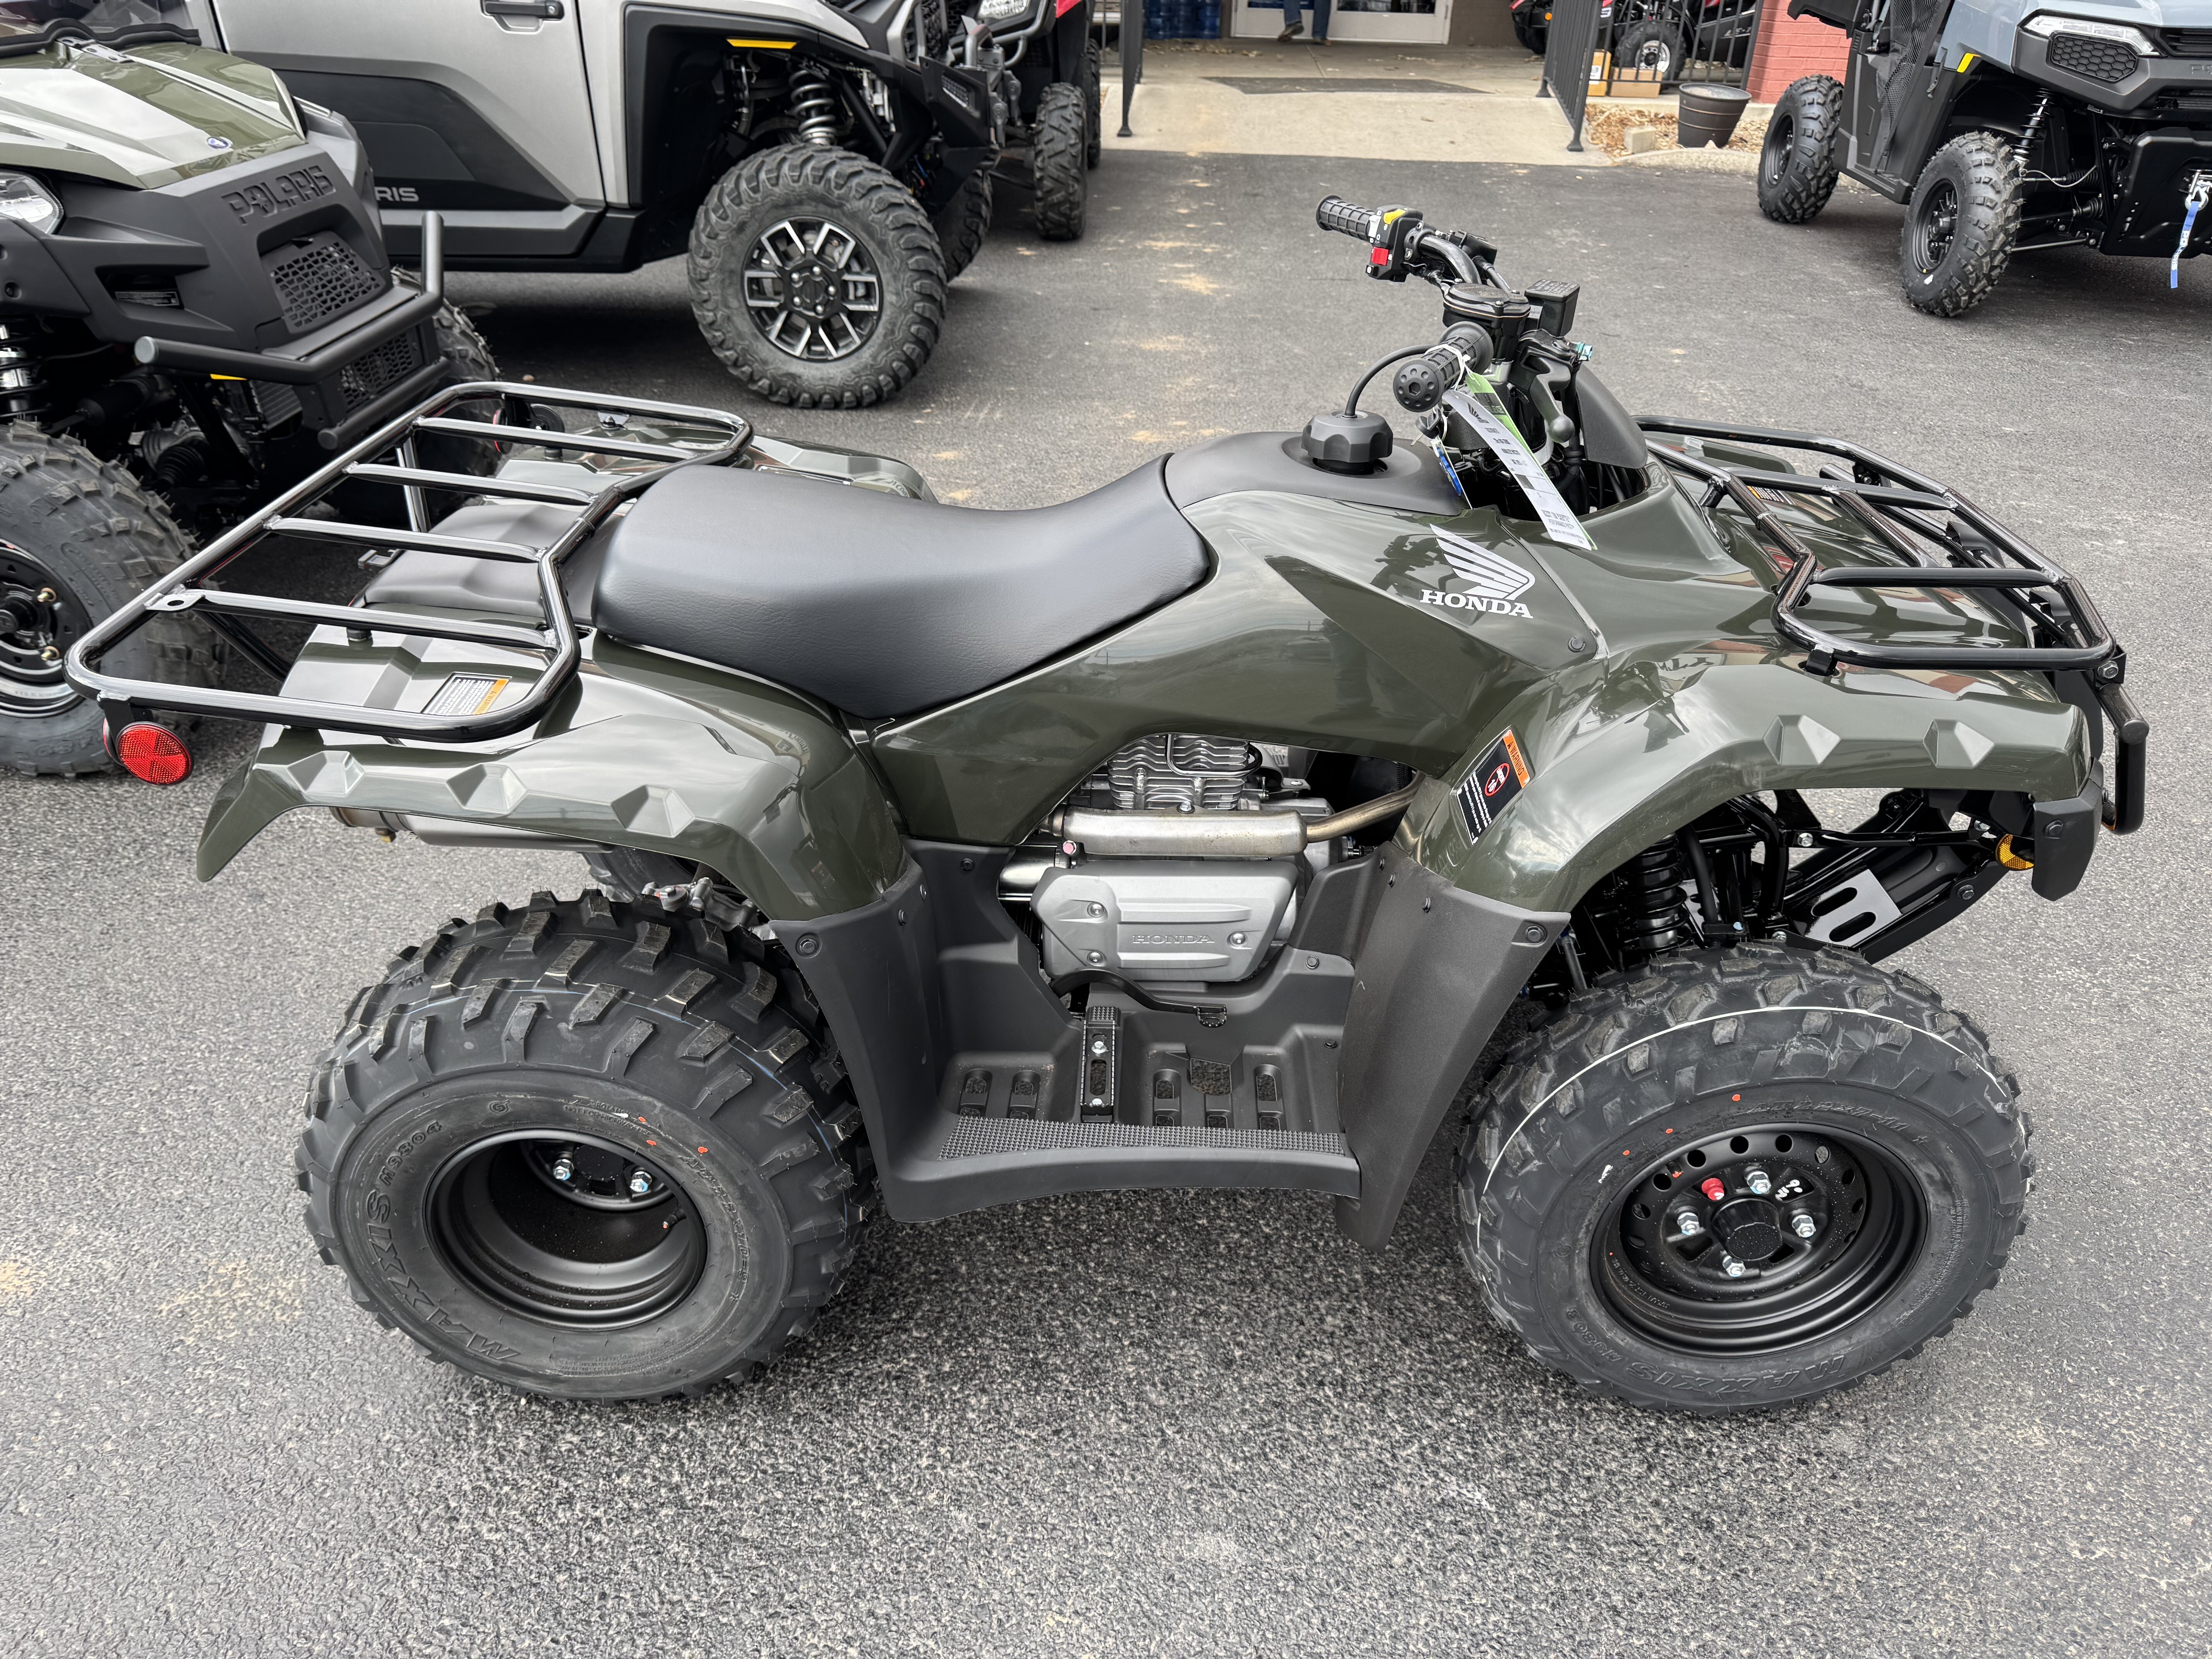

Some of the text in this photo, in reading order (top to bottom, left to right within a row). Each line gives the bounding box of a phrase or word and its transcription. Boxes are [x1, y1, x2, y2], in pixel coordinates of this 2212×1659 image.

[220, 165, 336, 226] POLARIS
[2171, 230, 2190, 271] POLARIS
[1419, 589, 1534, 620] HONDA
[1510, 746, 1524, 776] WARNING
[1488, 779, 1497, 792] 16
[1132, 934, 1215, 944] HONDA
[378, 1121, 442, 1186] M9804
[366, 1190, 521, 1360] MAXXIS
[1626, 1355, 1846, 1393] MAXXIS
